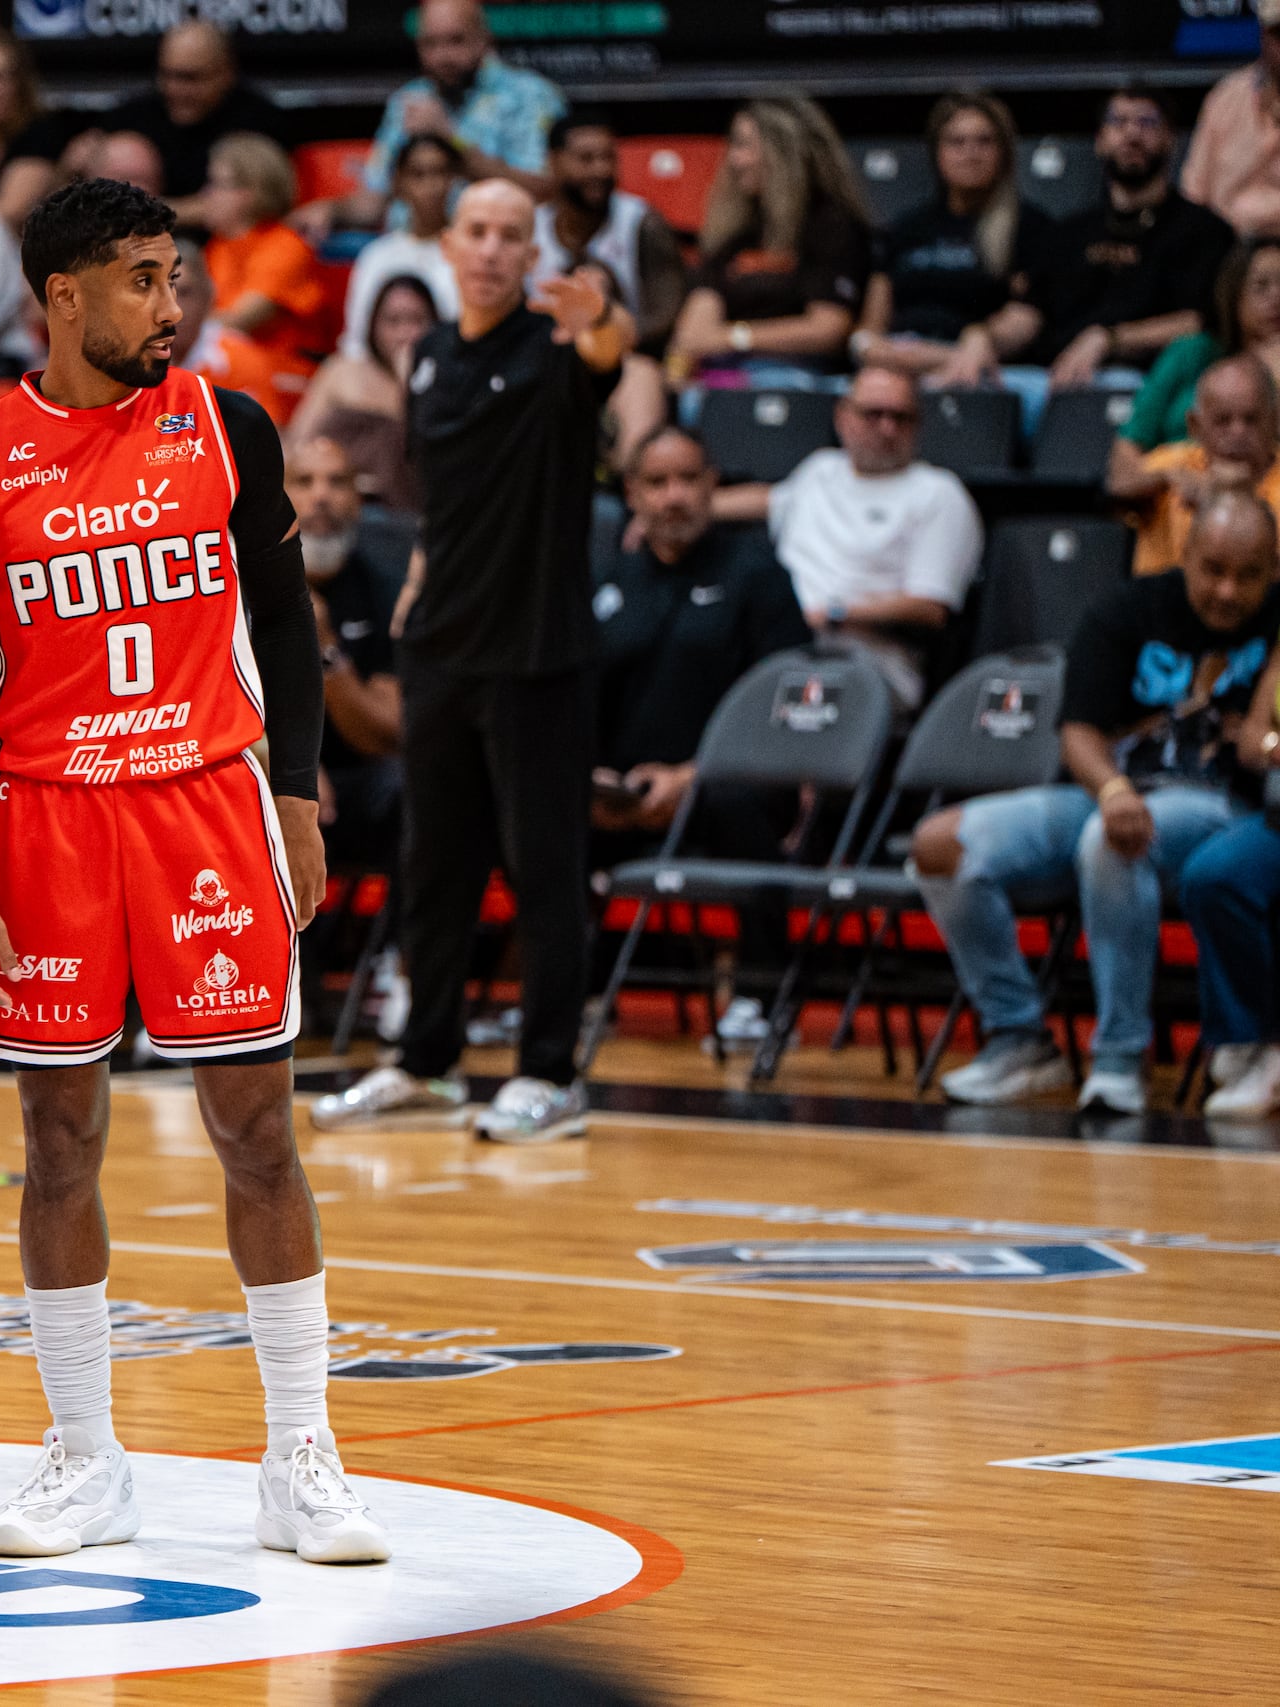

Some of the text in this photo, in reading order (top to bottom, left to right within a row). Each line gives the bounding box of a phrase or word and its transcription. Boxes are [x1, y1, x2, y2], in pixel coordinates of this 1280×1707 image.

[144, 445, 189, 462] TURISMO
[1, 464, 68, 491] equiply
[42, 499, 160, 541] Claro
[6, 531, 226, 625] PONCE
[106, 622, 155, 696] 0
[65, 701, 191, 740] SUNOCO
[129, 739, 199, 762] MASTER
[130, 754, 204, 777] MOTORS
[171, 901, 254, 943] Wendy's
[176, 984, 271, 1008] LOTERÍA
[205, 1008, 238, 1016] PUERTO
[240, 1005, 259, 1013] RICO
